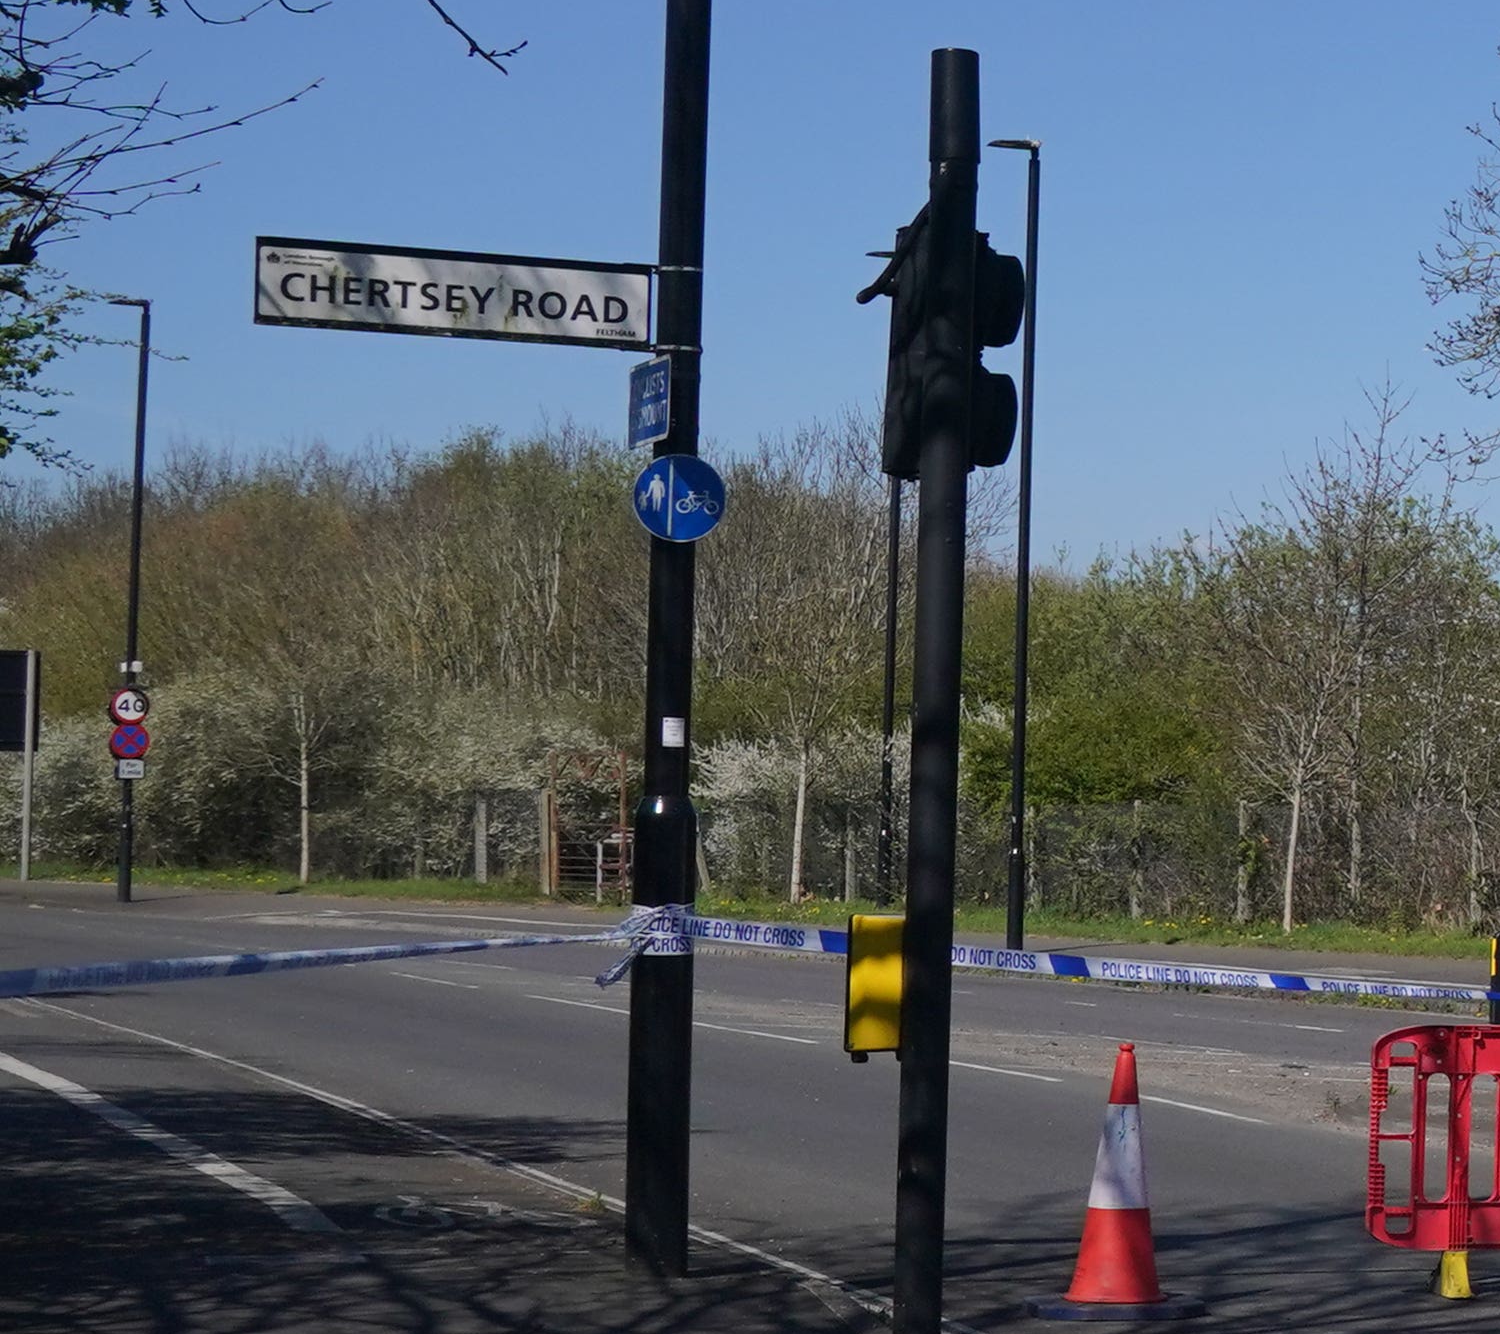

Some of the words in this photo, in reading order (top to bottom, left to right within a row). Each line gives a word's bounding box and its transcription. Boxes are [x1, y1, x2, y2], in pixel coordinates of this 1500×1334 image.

[280, 272, 496, 315] CHERTSEY
[511, 288, 629, 323] ROAD
[118, 698, 146, 714] 40
[681, 917, 710, 937] LINE
[713, 921, 732, 939] DO
[735, 924, 761, 942] NOT
[763, 926, 806, 948] CROSS
[951, 946, 966, 964] DO
[969, 948, 994, 966] NOT
[996, 951, 1037, 971] CROSS
[1102, 961, 1142, 980] POLICE
[1145, 965, 1172, 983] LINE
[1175, 968, 1191, 984] DO
[1194, 970, 1217, 986] NOT
[1219, 973, 1260, 989] CROSS
